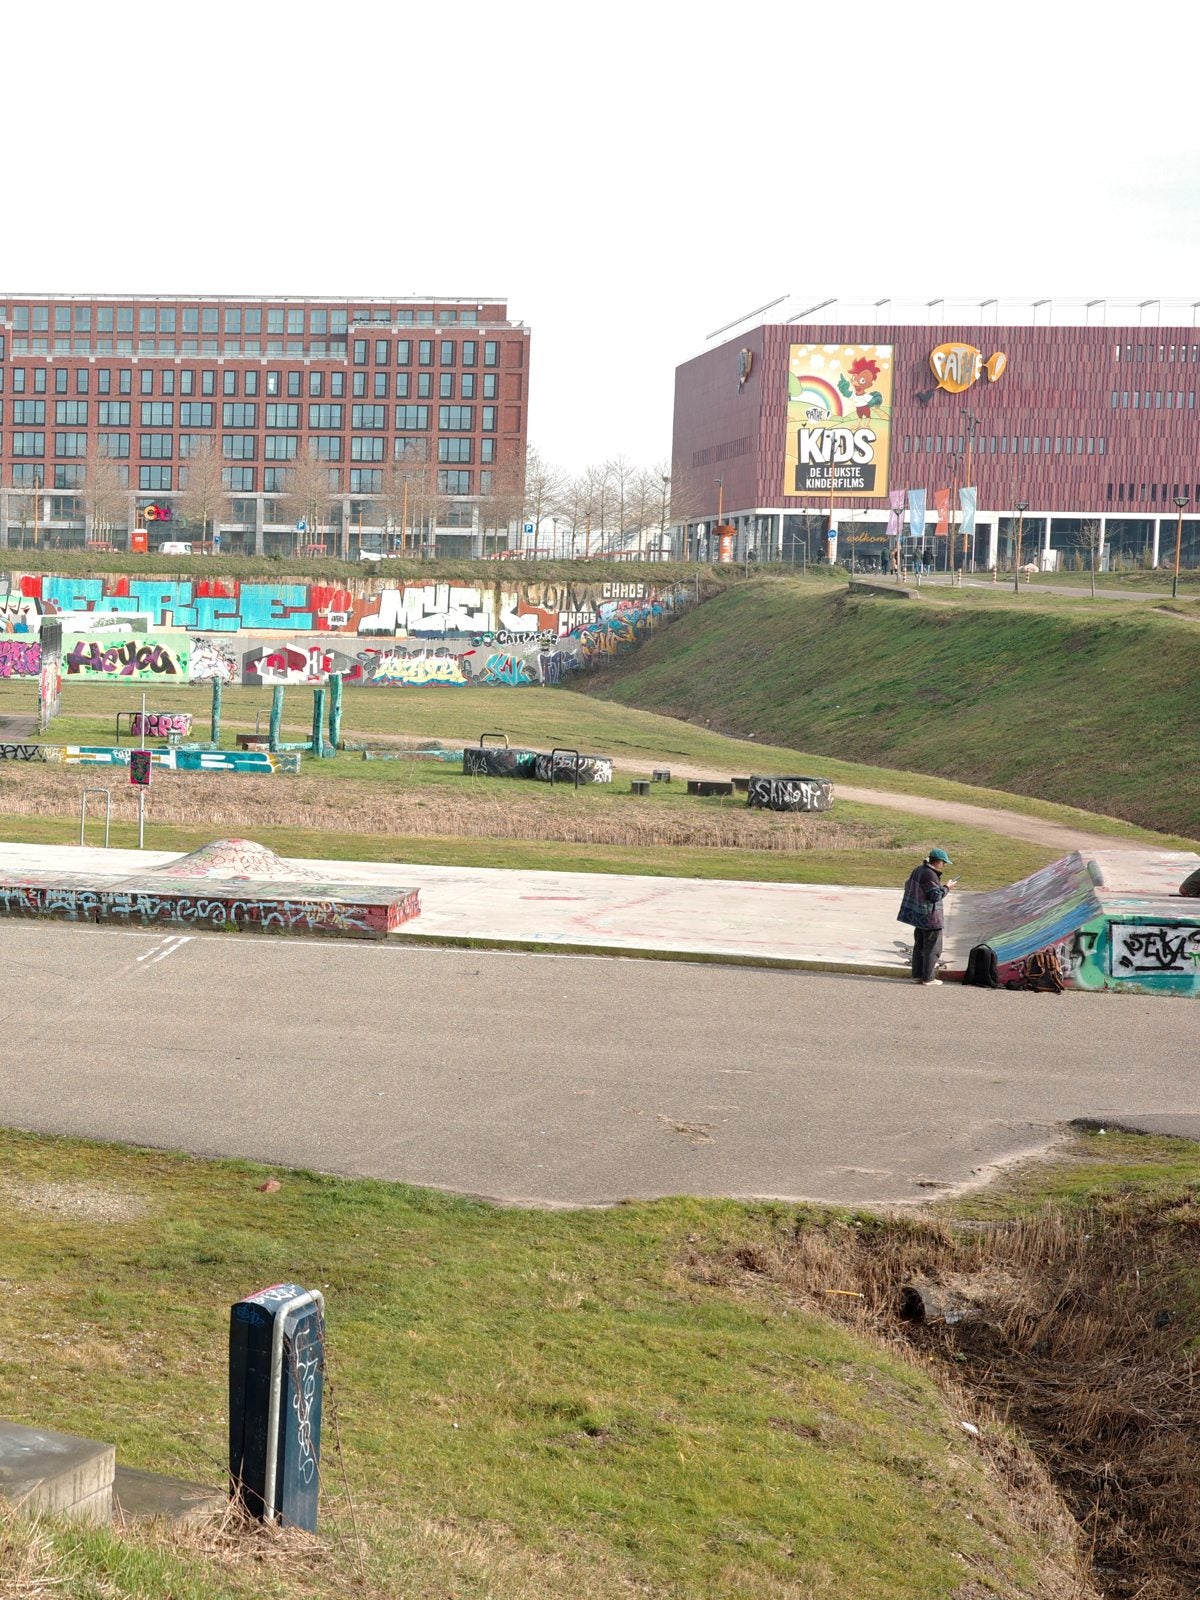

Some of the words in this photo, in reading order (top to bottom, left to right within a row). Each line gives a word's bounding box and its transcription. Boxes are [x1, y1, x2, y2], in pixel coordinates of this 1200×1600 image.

[810, 467, 822, 479] DE
[824, 467, 861, 478] LEUKSTE
[806, 478, 865, 488] KINDERFILMS
[846, 532, 888, 544] welkom
[603, 582, 645, 598] CHAOS
[558, 612, 597, 638] CHAOS
